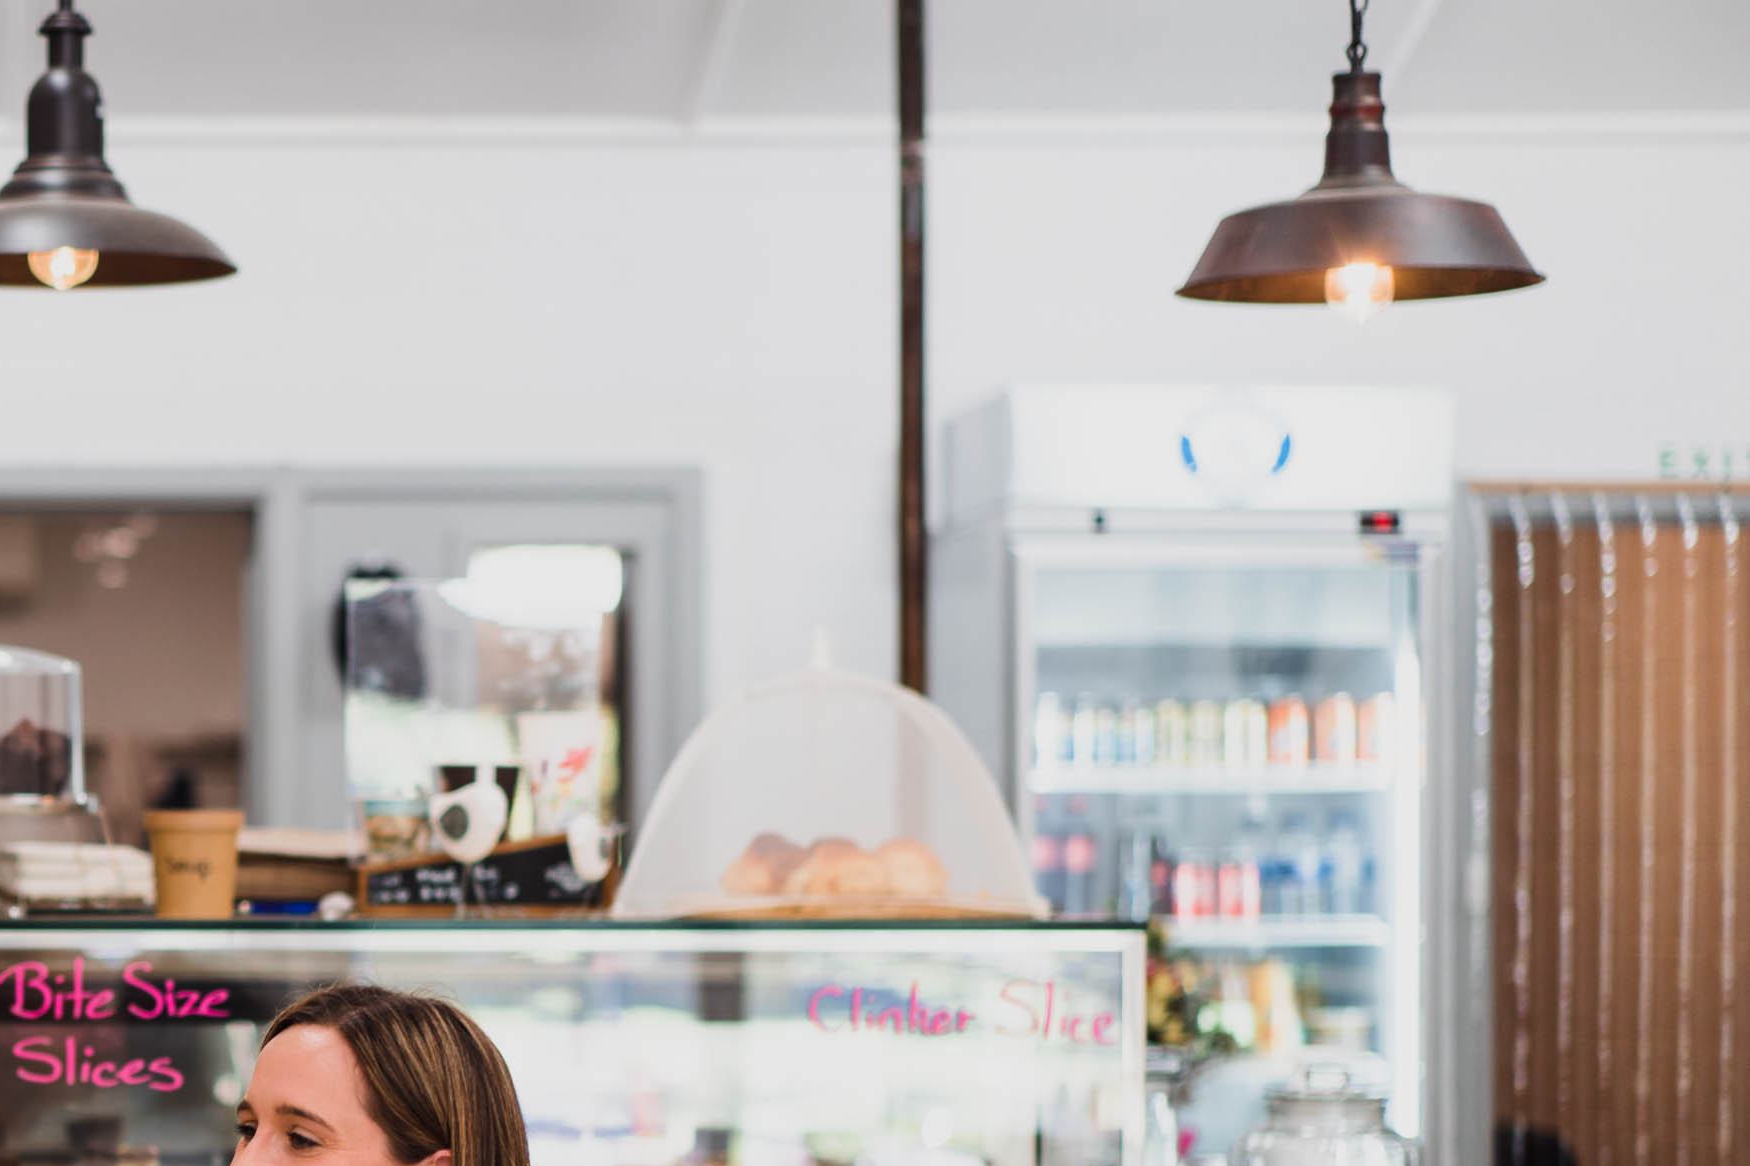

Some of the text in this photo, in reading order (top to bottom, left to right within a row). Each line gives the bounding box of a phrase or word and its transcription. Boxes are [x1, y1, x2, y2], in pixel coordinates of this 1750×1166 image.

[1658, 447, 1750, 478] EXI
[123, 960, 230, 1020] Size
[807, 978, 1116, 1046] Clinker Slice
[11, 1035, 185, 1093] Slices
